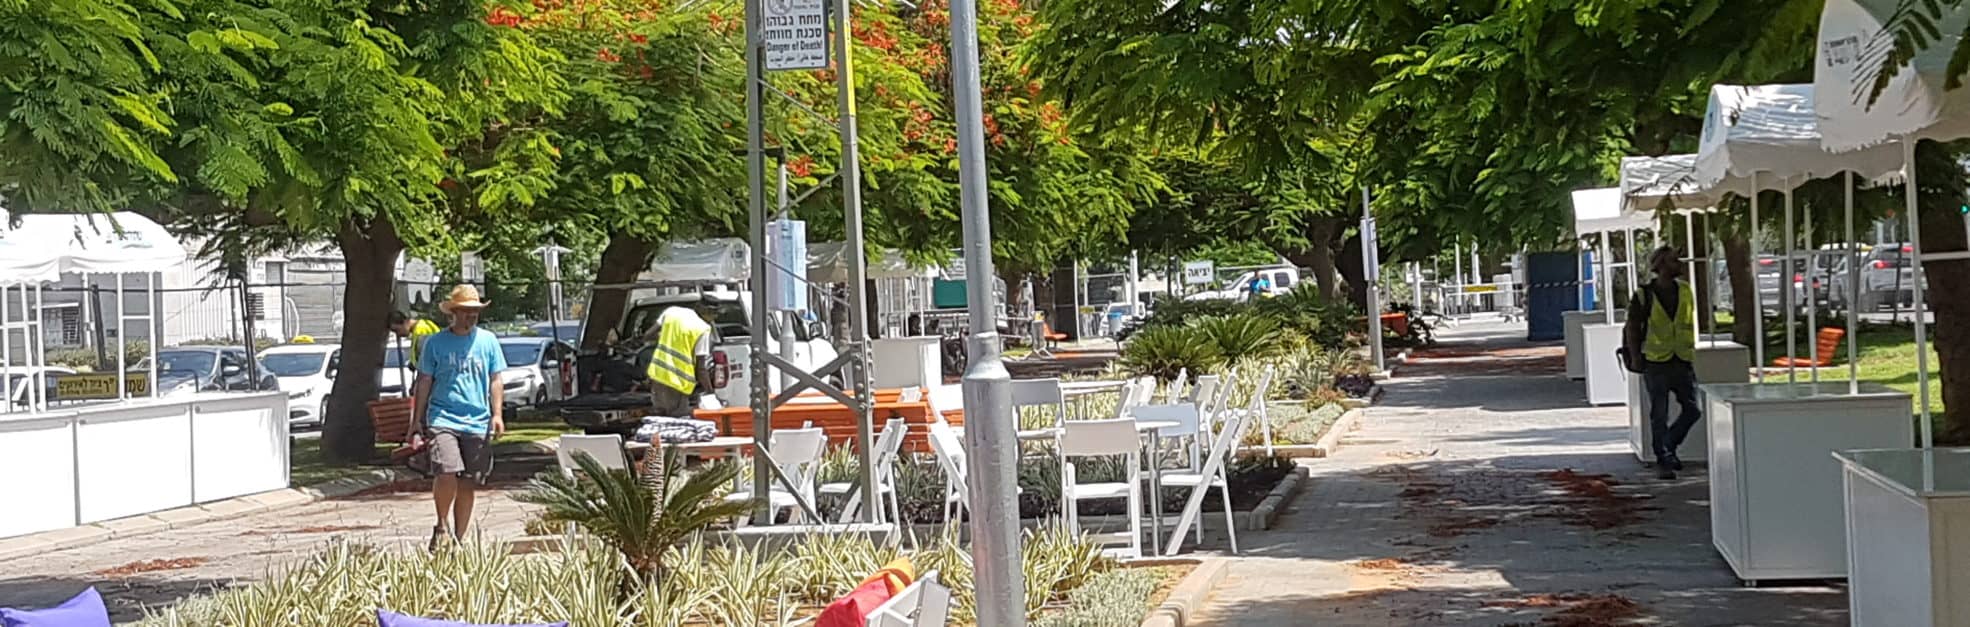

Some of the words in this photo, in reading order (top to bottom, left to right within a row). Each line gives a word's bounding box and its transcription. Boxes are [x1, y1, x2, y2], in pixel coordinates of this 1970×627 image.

[799, 14, 821, 24] מתח
[796, 28, 822, 38] סכנת
[767, 41, 790, 54] Danger
[792, 41, 799, 50] of
[1188, 266, 1210, 278] יציאה
